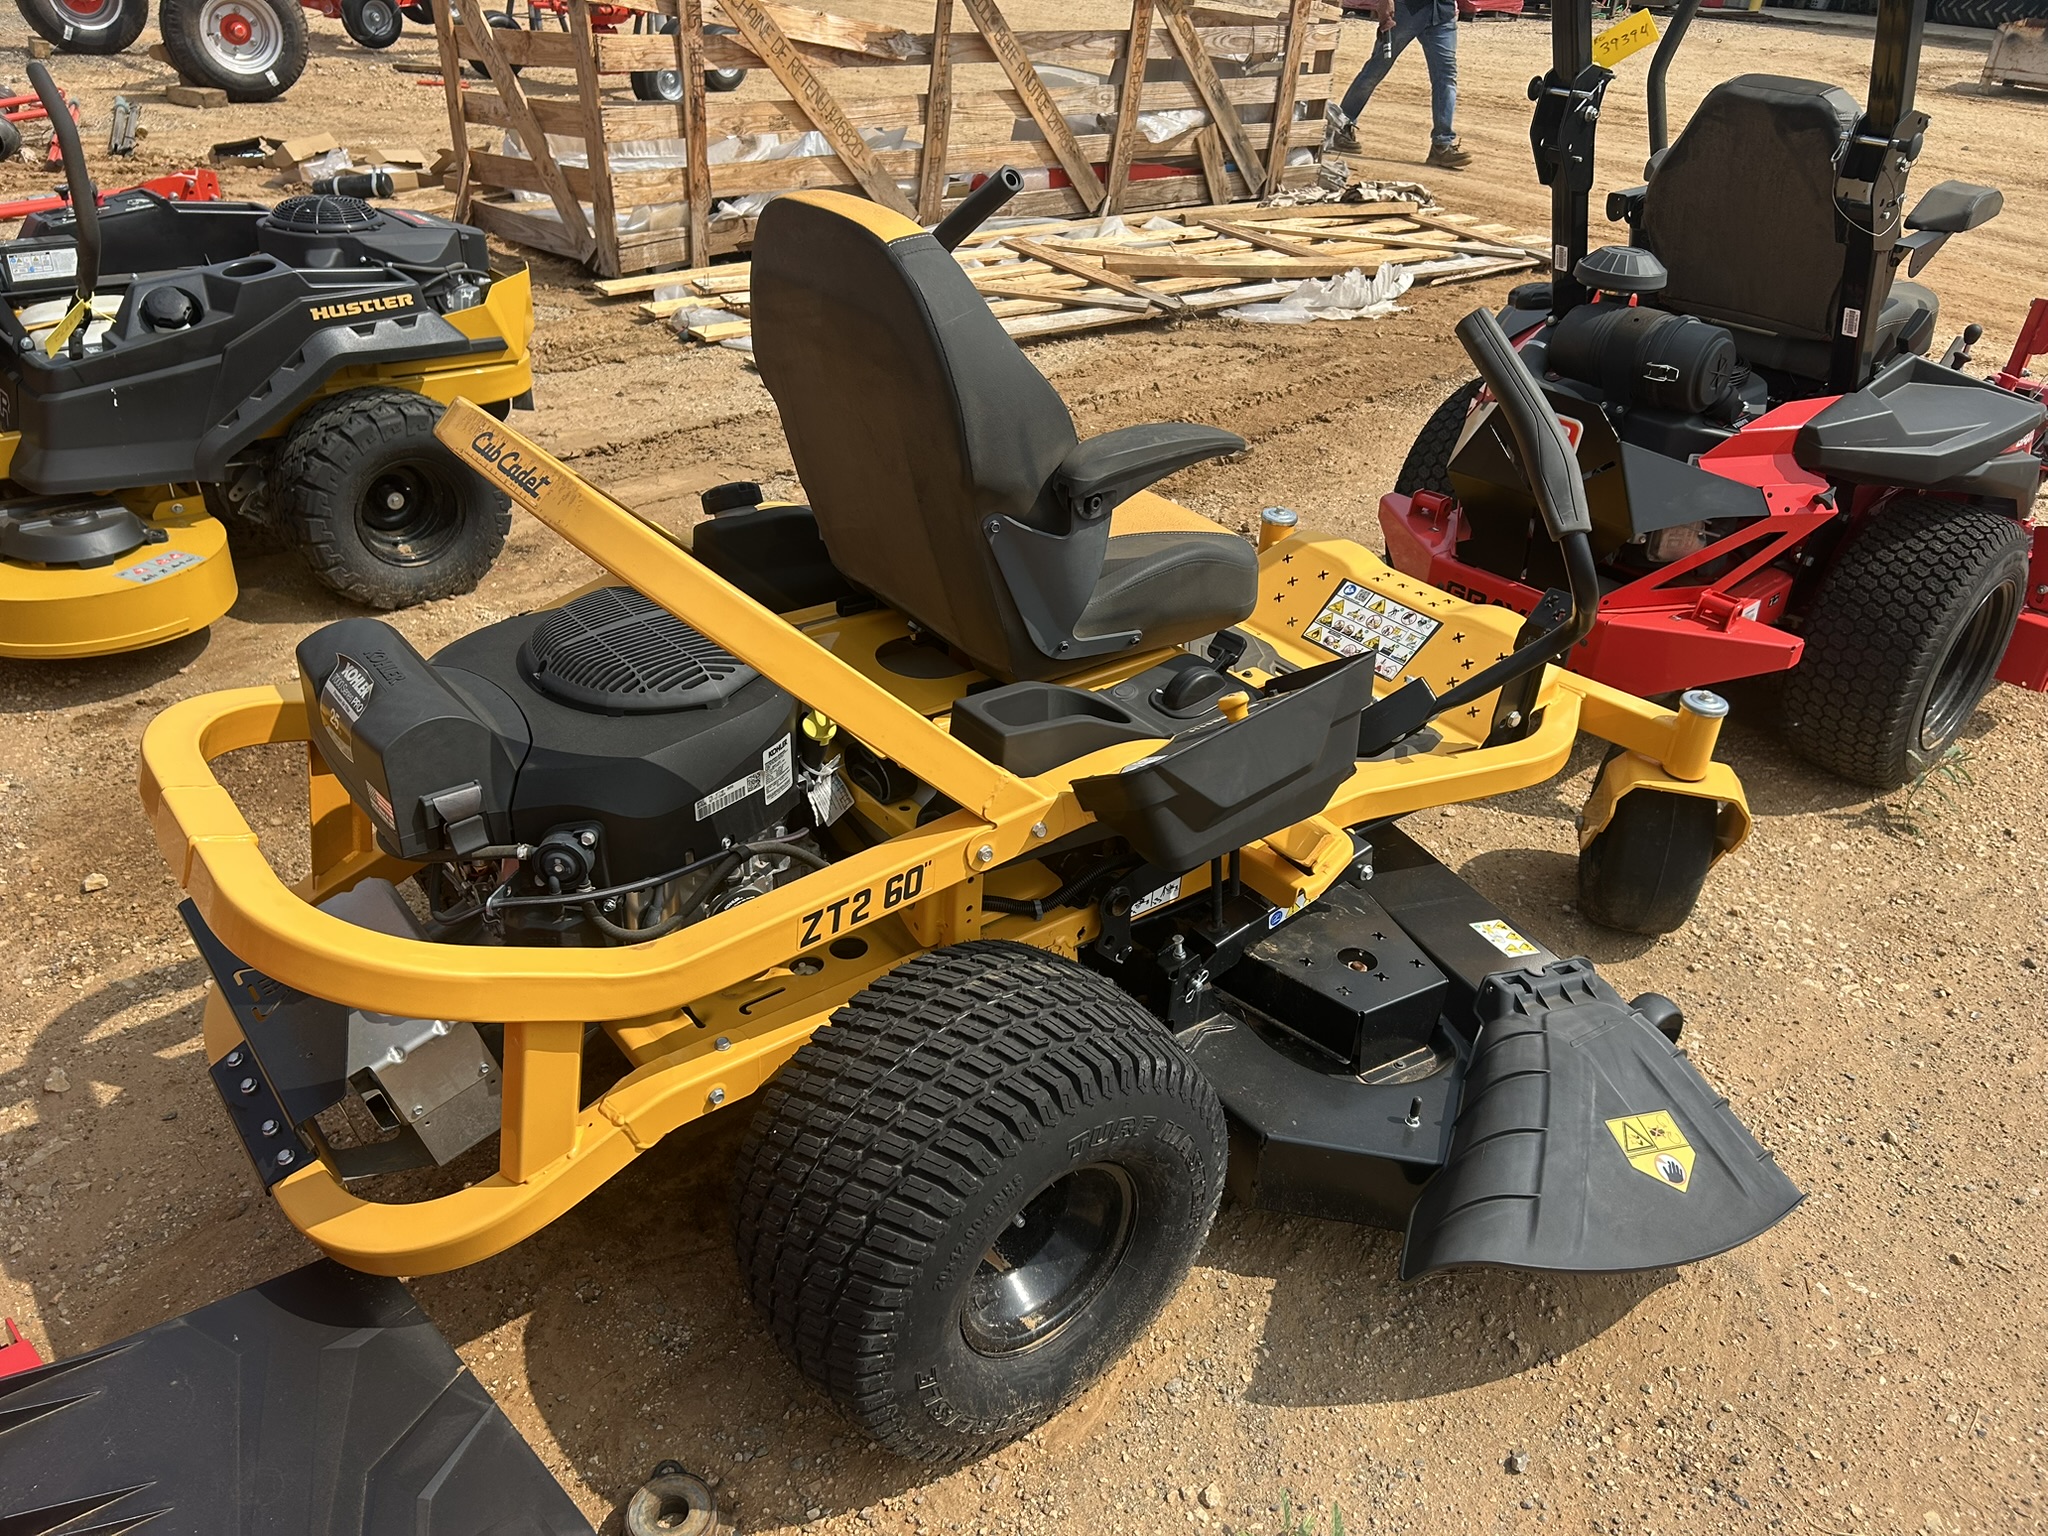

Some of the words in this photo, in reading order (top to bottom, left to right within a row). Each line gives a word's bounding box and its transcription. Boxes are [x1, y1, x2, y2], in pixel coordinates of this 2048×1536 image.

[1599, 22, 1649, 55] 39394
[309, 293, 414, 321] HUSTLER
[471, 431, 506, 463] Cub
[496, 451, 551, 499] Cadet
[341, 662, 370, 700] KOHLER
[362, 649, 406, 687] KOHLER
[329, 707, 341, 731] 25
[350, 696, 364, 714] PRO
[799, 888, 872, 949] ZT2
[883, 859, 932, 910] 60"
[1066, 1115, 1158, 1159] TURF
